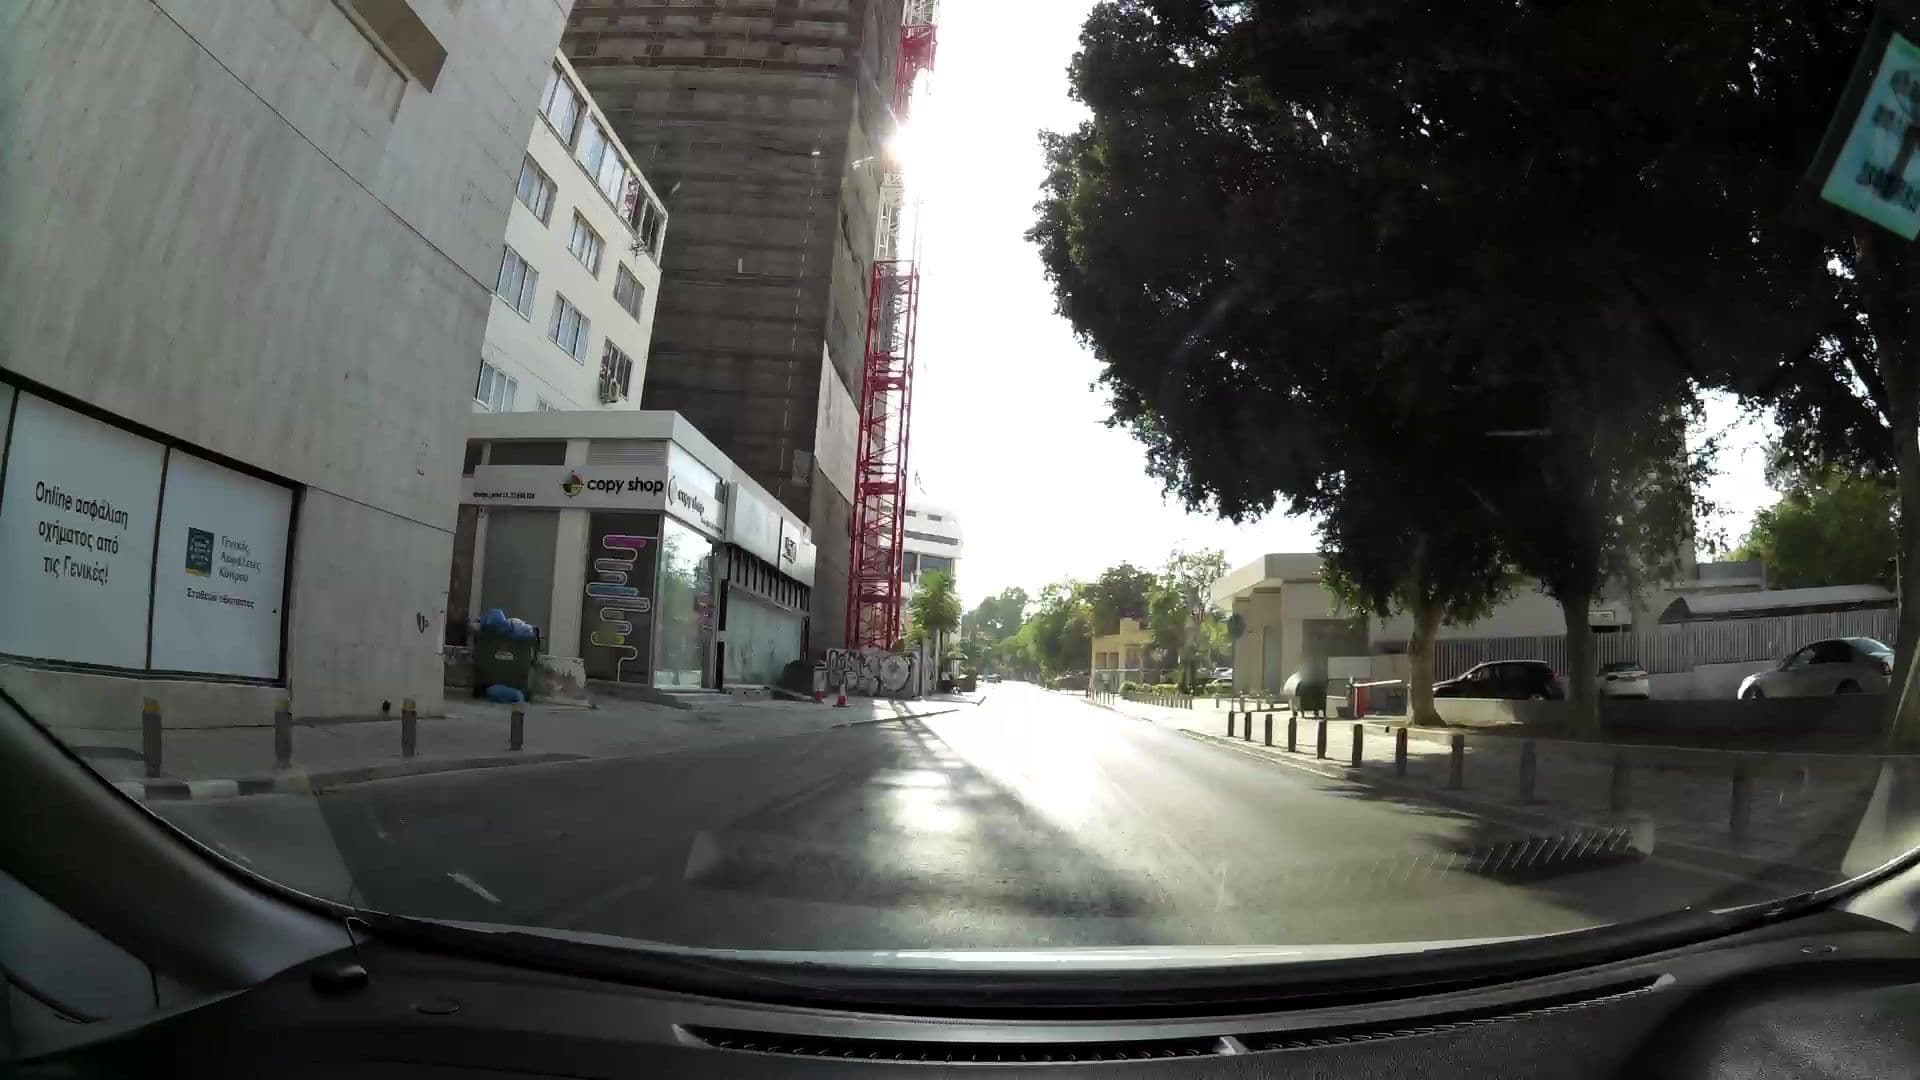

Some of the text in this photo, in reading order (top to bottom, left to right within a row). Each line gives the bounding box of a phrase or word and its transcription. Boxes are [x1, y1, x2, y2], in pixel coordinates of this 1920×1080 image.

[35, 480, 73, 511] Online
[587, 476, 664, 495] copy shop
[38, 519, 119, 554] οχήματος από
[43, 555, 109, 587] τις Γενικές!
